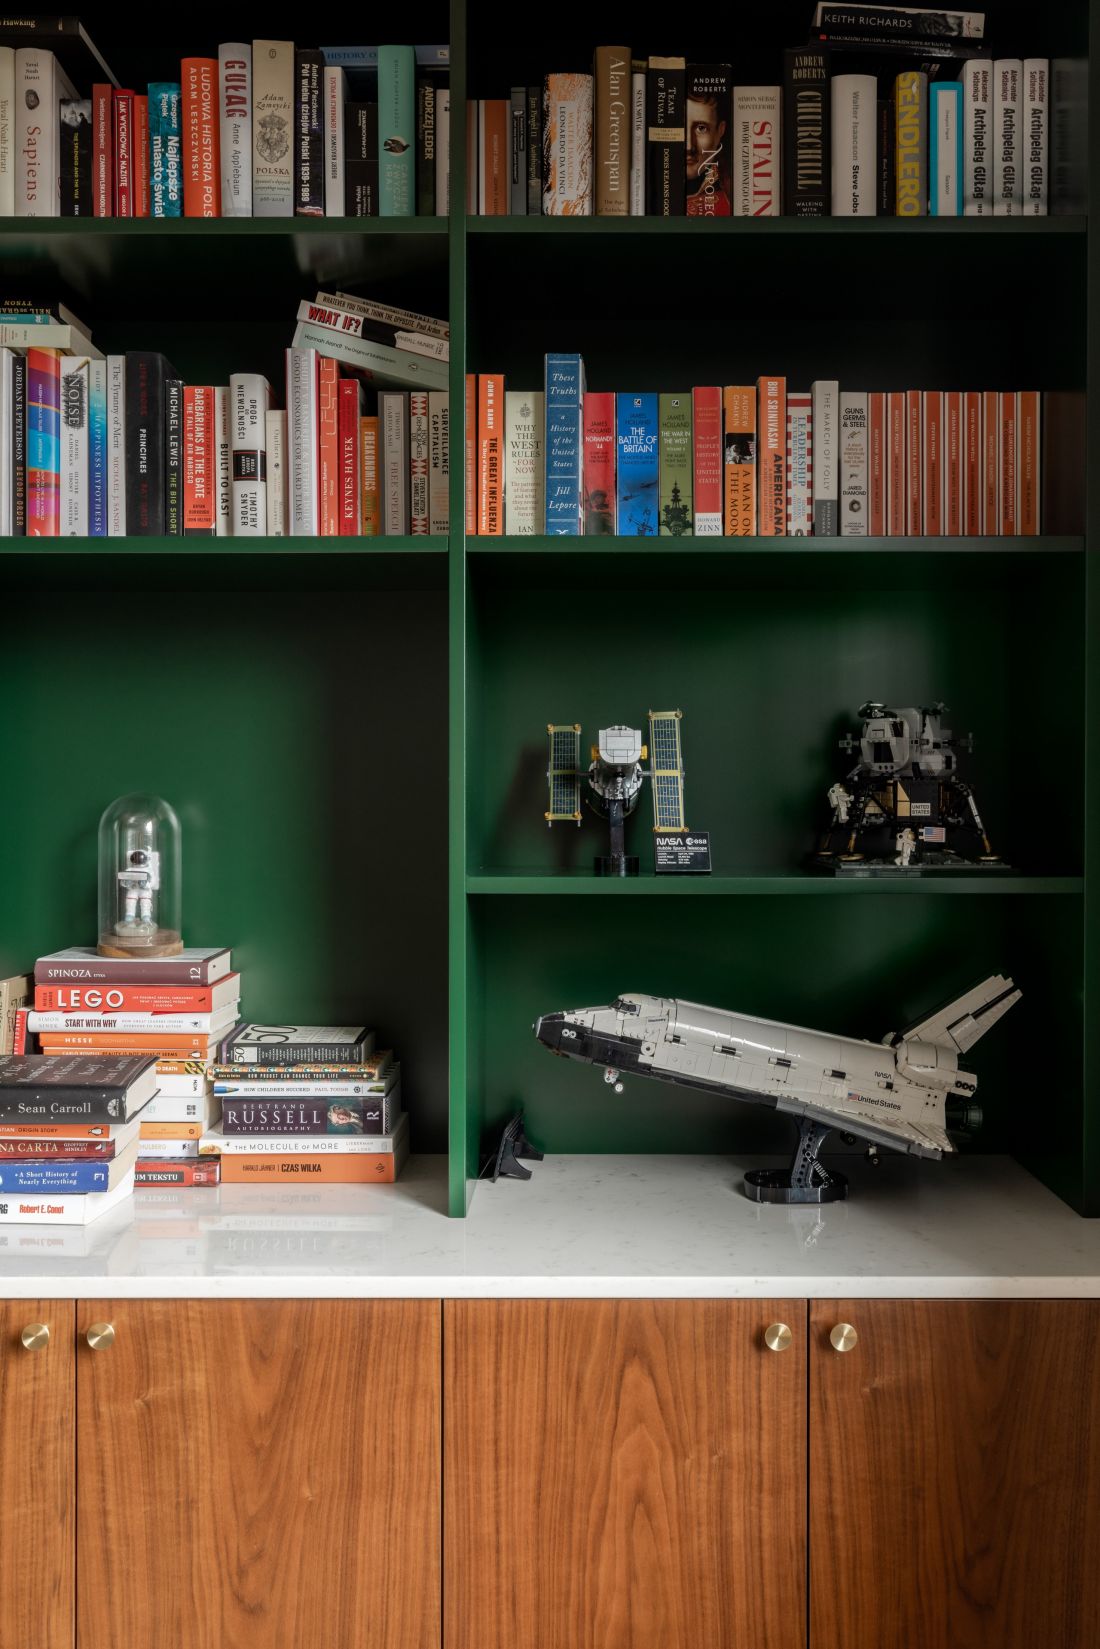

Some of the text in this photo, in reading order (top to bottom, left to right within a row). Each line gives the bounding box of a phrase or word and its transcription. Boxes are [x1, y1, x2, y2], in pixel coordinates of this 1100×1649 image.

[3, 17, 36, 28] Hawking
[824, 14, 912, 28] KEITH RICHARDS
[201, 67, 211, 120] LUDOWA
[224, 60, 248, 118] GUŁAG
[310, 64, 319, 129] Andrzej Paczkowski
[658, 77, 666, 124] OF RIVALS
[668, 87, 677, 114] TEAM
[170, 94, 178, 128] Grzegorz
[190, 67, 200, 182] ADAM LESZCZYŃSKI
[424, 87, 434, 160] ANDRZEJ LEDER
[604, 56, 625, 192] Alan Greenspan
[118, 101, 128, 187] JAK WYCHOWAĆ NAZISTĘ
[796, 91, 822, 190] CHURCHILL
[973, 108, 986, 162] Archipelag
[23, 126, 40, 201] Sapiens
[153, 136, 163, 182] miasto
[202, 125, 212, 182] HISTORIA
[559, 156, 566, 167] DA
[166, 136, 180, 200] Najlepsze
[232, 150, 241, 196] Applebaum
[753, 121, 772, 216] STALIN
[308, 306, 340, 326] WHAT
[342, 314, 361, 332] IF?
[68, 377, 79, 425] NOISE
[111, 382, 121, 415] Tyranny
[550, 386, 576, 395] Truths
[768, 382, 778, 397] BHU
[113, 417, 120, 426] of
[170, 387, 178, 431] MICHAEL
[237, 385, 246, 440] NIEWOLNOŚCI
[631, 427, 645, 435] THE
[768, 400, 778, 448] SRINIVASAN
[195, 389, 204, 498] BARBARIANS AT THE GATE
[510, 441, 541, 449] WEST
[618, 436, 657, 444] BATTLE OF
[364, 431, 375, 490] FREAKONOMICS
[824, 449, 830, 460] OF
[221, 476, 228, 487] TO
[489, 457, 497, 483] GREAT
[221, 493, 229, 517] LAST
[555, 487, 569, 496] Jill
[742, 481, 750, 511] MAN
[774, 454, 782, 535] AMERICANA
[489, 487, 498, 533] INFLUENZA
[549, 502, 576, 510] Lepore
[730, 498, 738, 536] MOON
[742, 518, 750, 536] ON
[48, 969, 91, 978] SPINOZA
[190, 967, 201, 979] 12
[58, 989, 124, 1008] LEGO
[65, 1019, 117, 1028] START WITH WHY
[874, 1071, 892, 1080] NASA
[18, 1103, 91, 1113] Sean Carroll
[857, 1095, 901, 1110] United States
[228, 1111, 320, 1124] RUSSELL
[18, 1143, 58, 1152] CARTA
[147, 1173, 178, 1181] TEKSTU
[282, 1164, 299, 1172] CZAS
[301, 1164, 321, 1172] WILKA
[19, 1204, 64, 1214] Robert E. Conot
